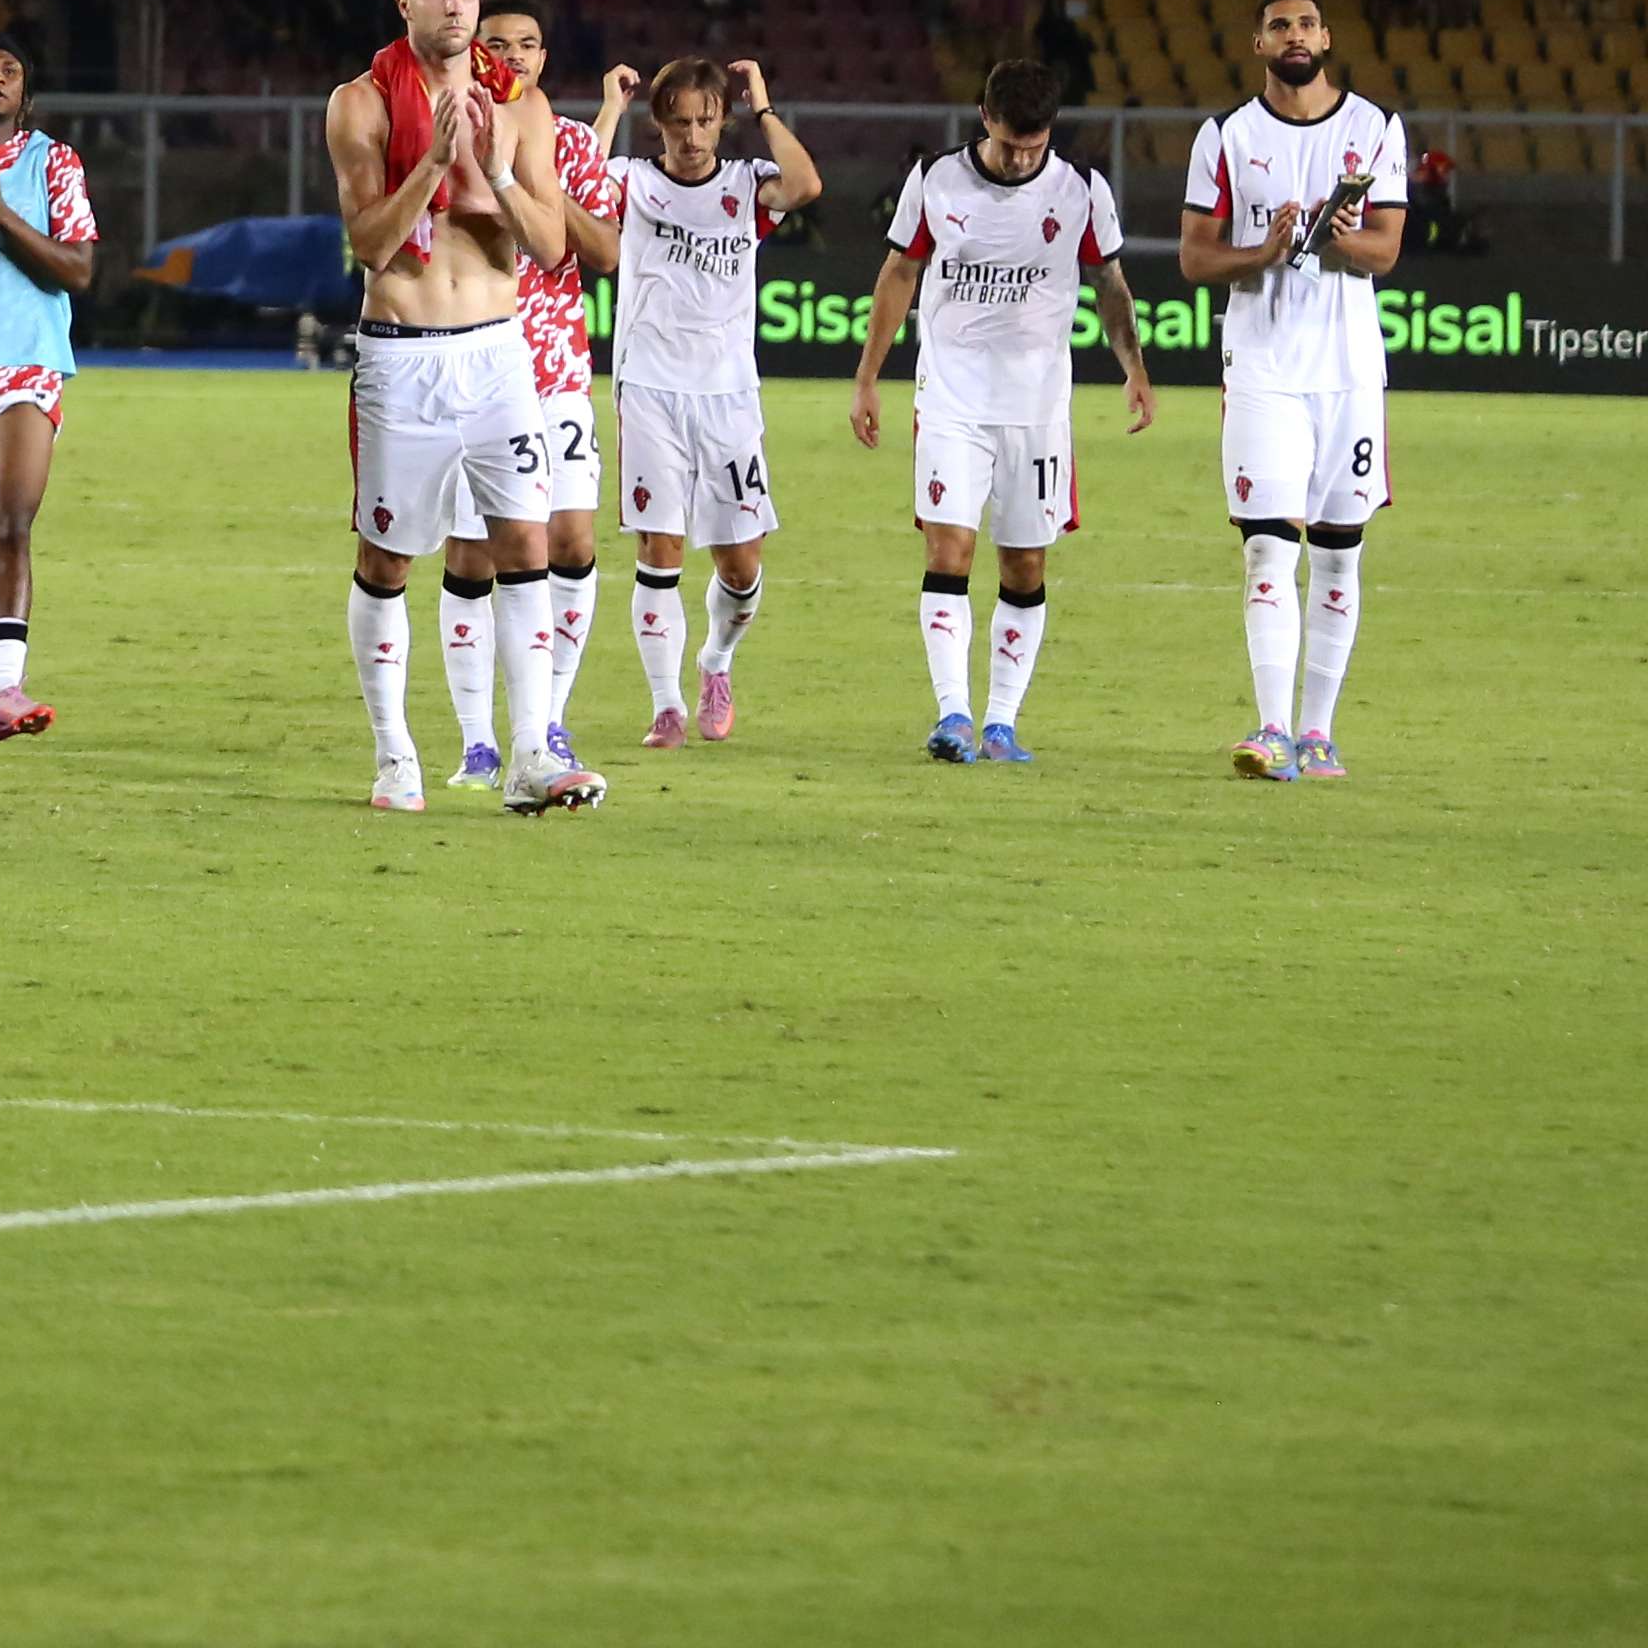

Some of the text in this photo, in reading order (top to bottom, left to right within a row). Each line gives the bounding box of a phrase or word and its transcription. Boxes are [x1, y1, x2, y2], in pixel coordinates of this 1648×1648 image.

[666, 243, 739, 277] FLY BETTER
[941, 257, 1052, 285] Emirates
[952, 281, 1030, 304] FLY BETTER
[370, 323, 399, 336] BOSS
[1376, 289, 1522, 356] Sisal
[1351, 436, 1373, 477] 8
[725, 454, 766, 501] 14
[1033, 455, 1058, 500] 11
